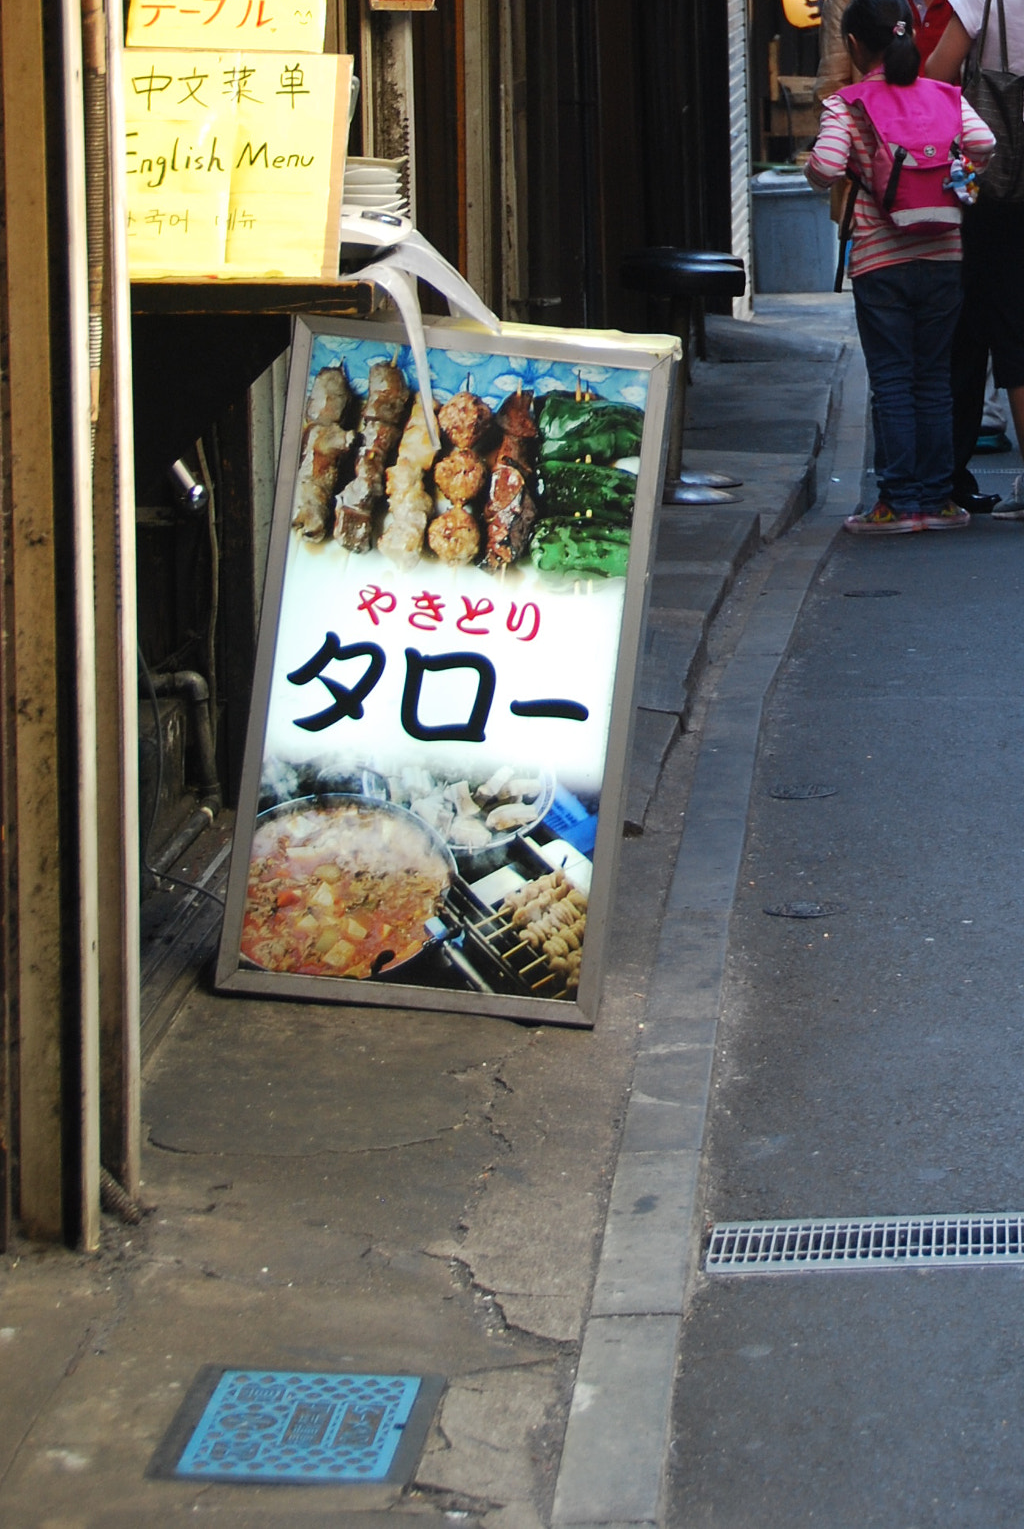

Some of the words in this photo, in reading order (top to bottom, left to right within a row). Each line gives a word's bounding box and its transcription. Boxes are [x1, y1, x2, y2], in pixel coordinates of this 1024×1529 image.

[131, 62, 311, 112] 中文菜单
[125, 132, 225, 188] English
[235, 141, 315, 170] Menu
[356, 583, 543, 643] やきとり
[285, 630, 591, 744] タロー
